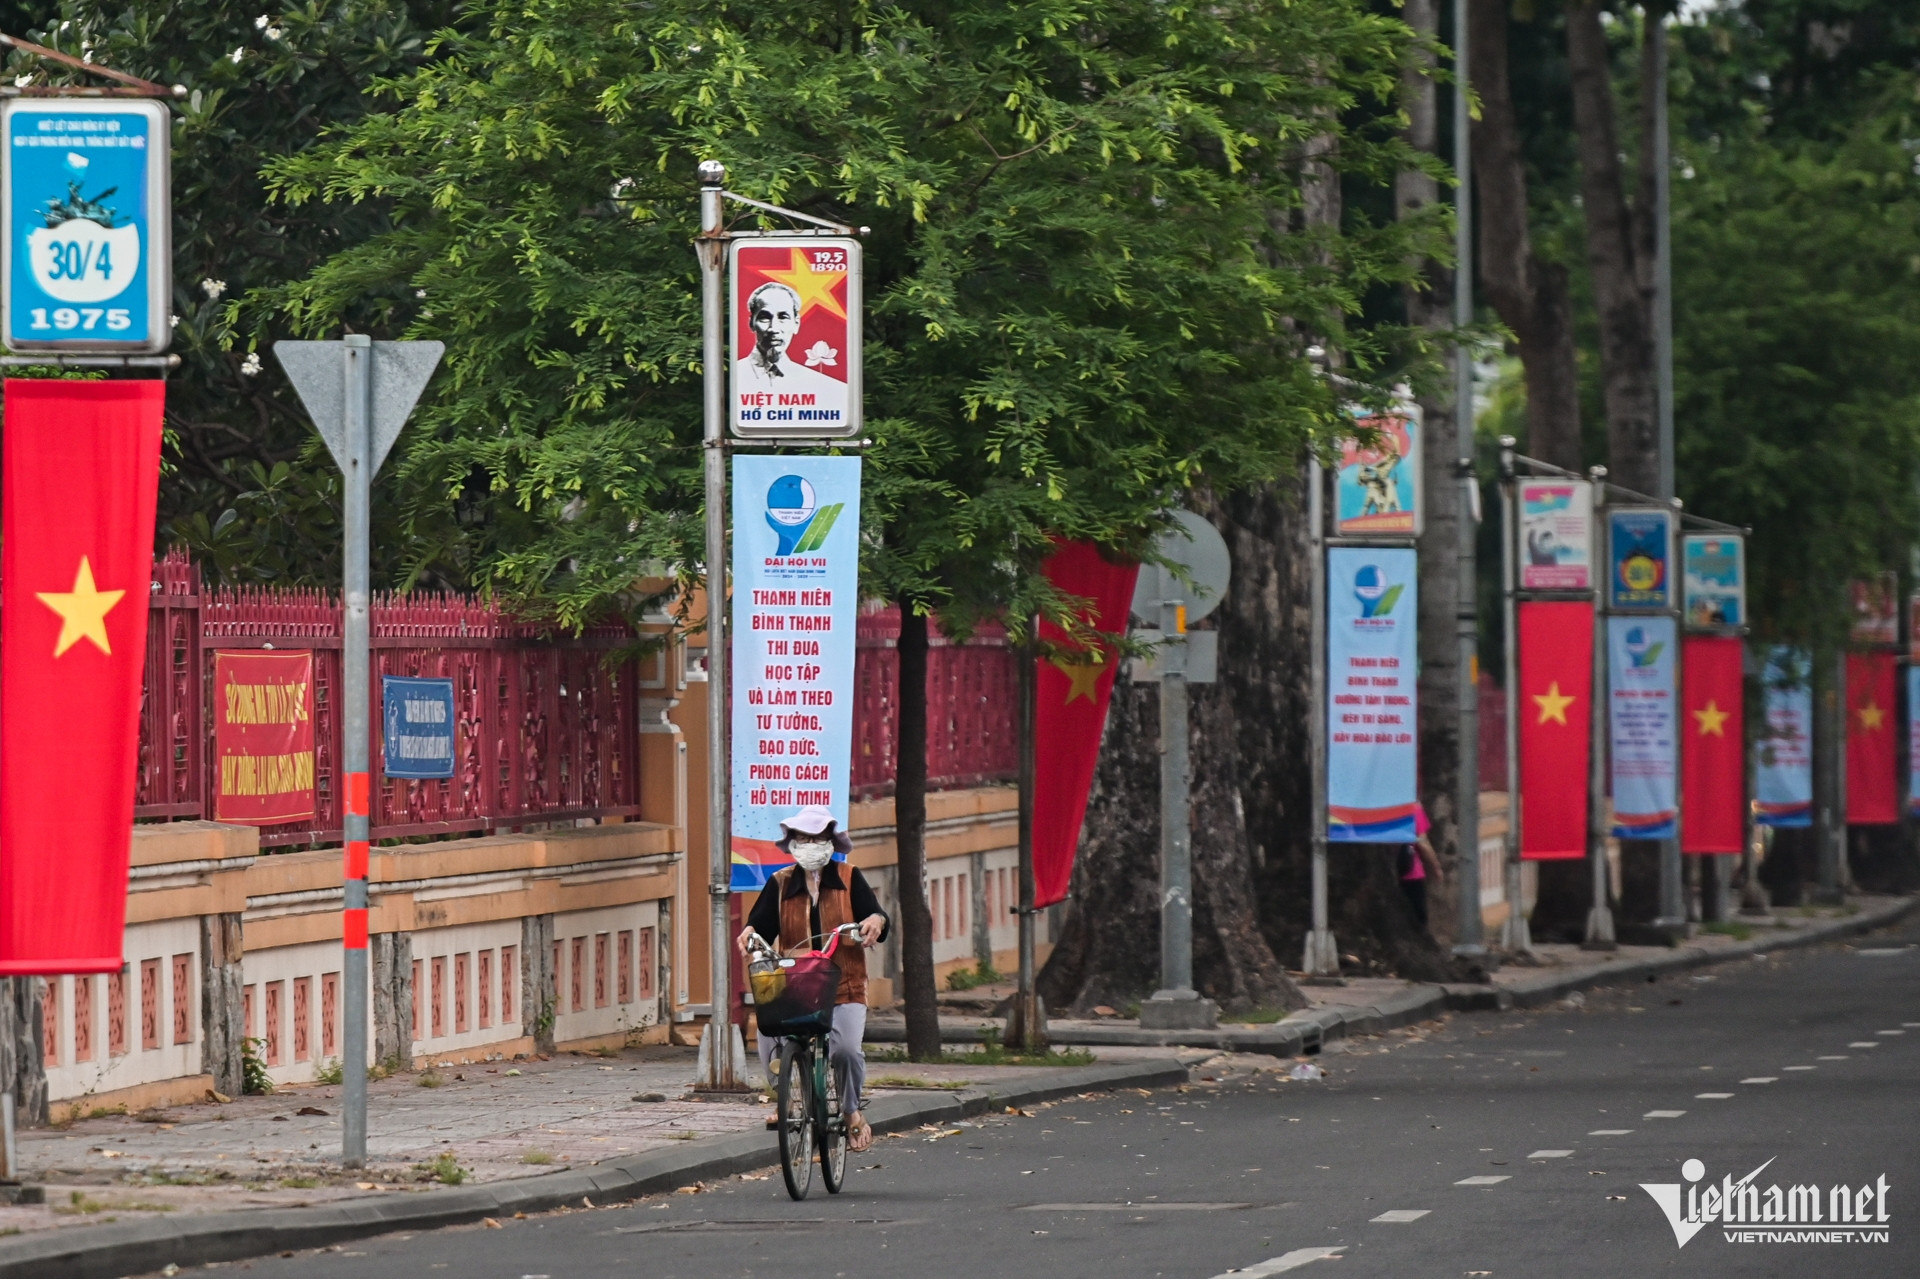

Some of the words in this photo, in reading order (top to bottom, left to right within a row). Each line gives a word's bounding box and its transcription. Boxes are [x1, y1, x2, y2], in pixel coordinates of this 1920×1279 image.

[48, 240, 113, 280] 30/4
[814, 252, 844, 263] 19.5
[810, 263, 847, 272] 1890
[30, 308, 131, 330] 1975
[740, 391, 774, 407] VIỆT
[778, 394, 816, 406] NAM
[767, 408, 793, 421] CHÍ
[798, 410, 840, 420] MINH
[764, 558, 784, 568] ĐẠI
[788, 556, 808, 568] HỘI
[811, 558, 826, 566] VII
[752, 590, 796, 606] THANH
[801, 588, 832, 606] NIÊN
[752, 612, 784, 630] BÌNH
[789, 616, 831, 634] THẠNH
[768, 640, 788, 655] THI
[792, 640, 819, 656] ĐUA
[766, 665, 792, 684] HỌC
[797, 662, 820, 684] TẬP
[748, 686, 763, 705] VÀ
[768, 687, 796, 706] LÀM
[802, 690, 832, 706] THEO
[757, 714, 772, 730] TƯ
[777, 711, 823, 731] TƯỞNG,
[759, 740, 784, 758] ĐẠO
[789, 737, 820, 756] ĐỨC,
[750, 764, 791, 780] PHONG
[796, 762, 828, 780] CÁCH
[751, 784, 766, 805] HỒ
[770, 788, 792, 805] CHÍ
[796, 790, 830, 806] MINH
